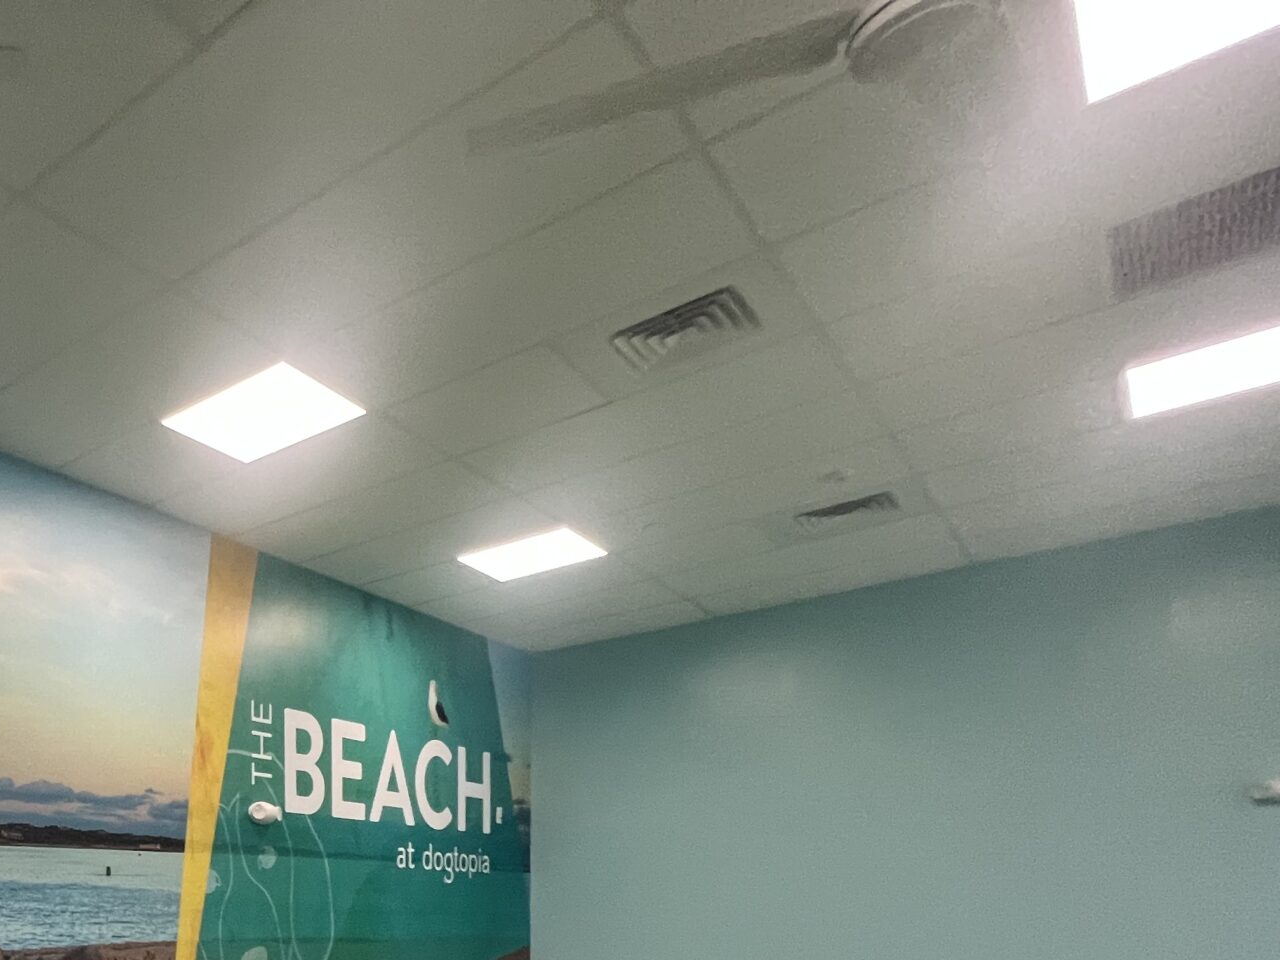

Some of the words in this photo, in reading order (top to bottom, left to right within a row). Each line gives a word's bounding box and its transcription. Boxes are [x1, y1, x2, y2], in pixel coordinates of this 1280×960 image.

[251, 700, 273, 785] THE
[396, 841, 416, 869] at
[422, 843, 490, 883] dogtopia
